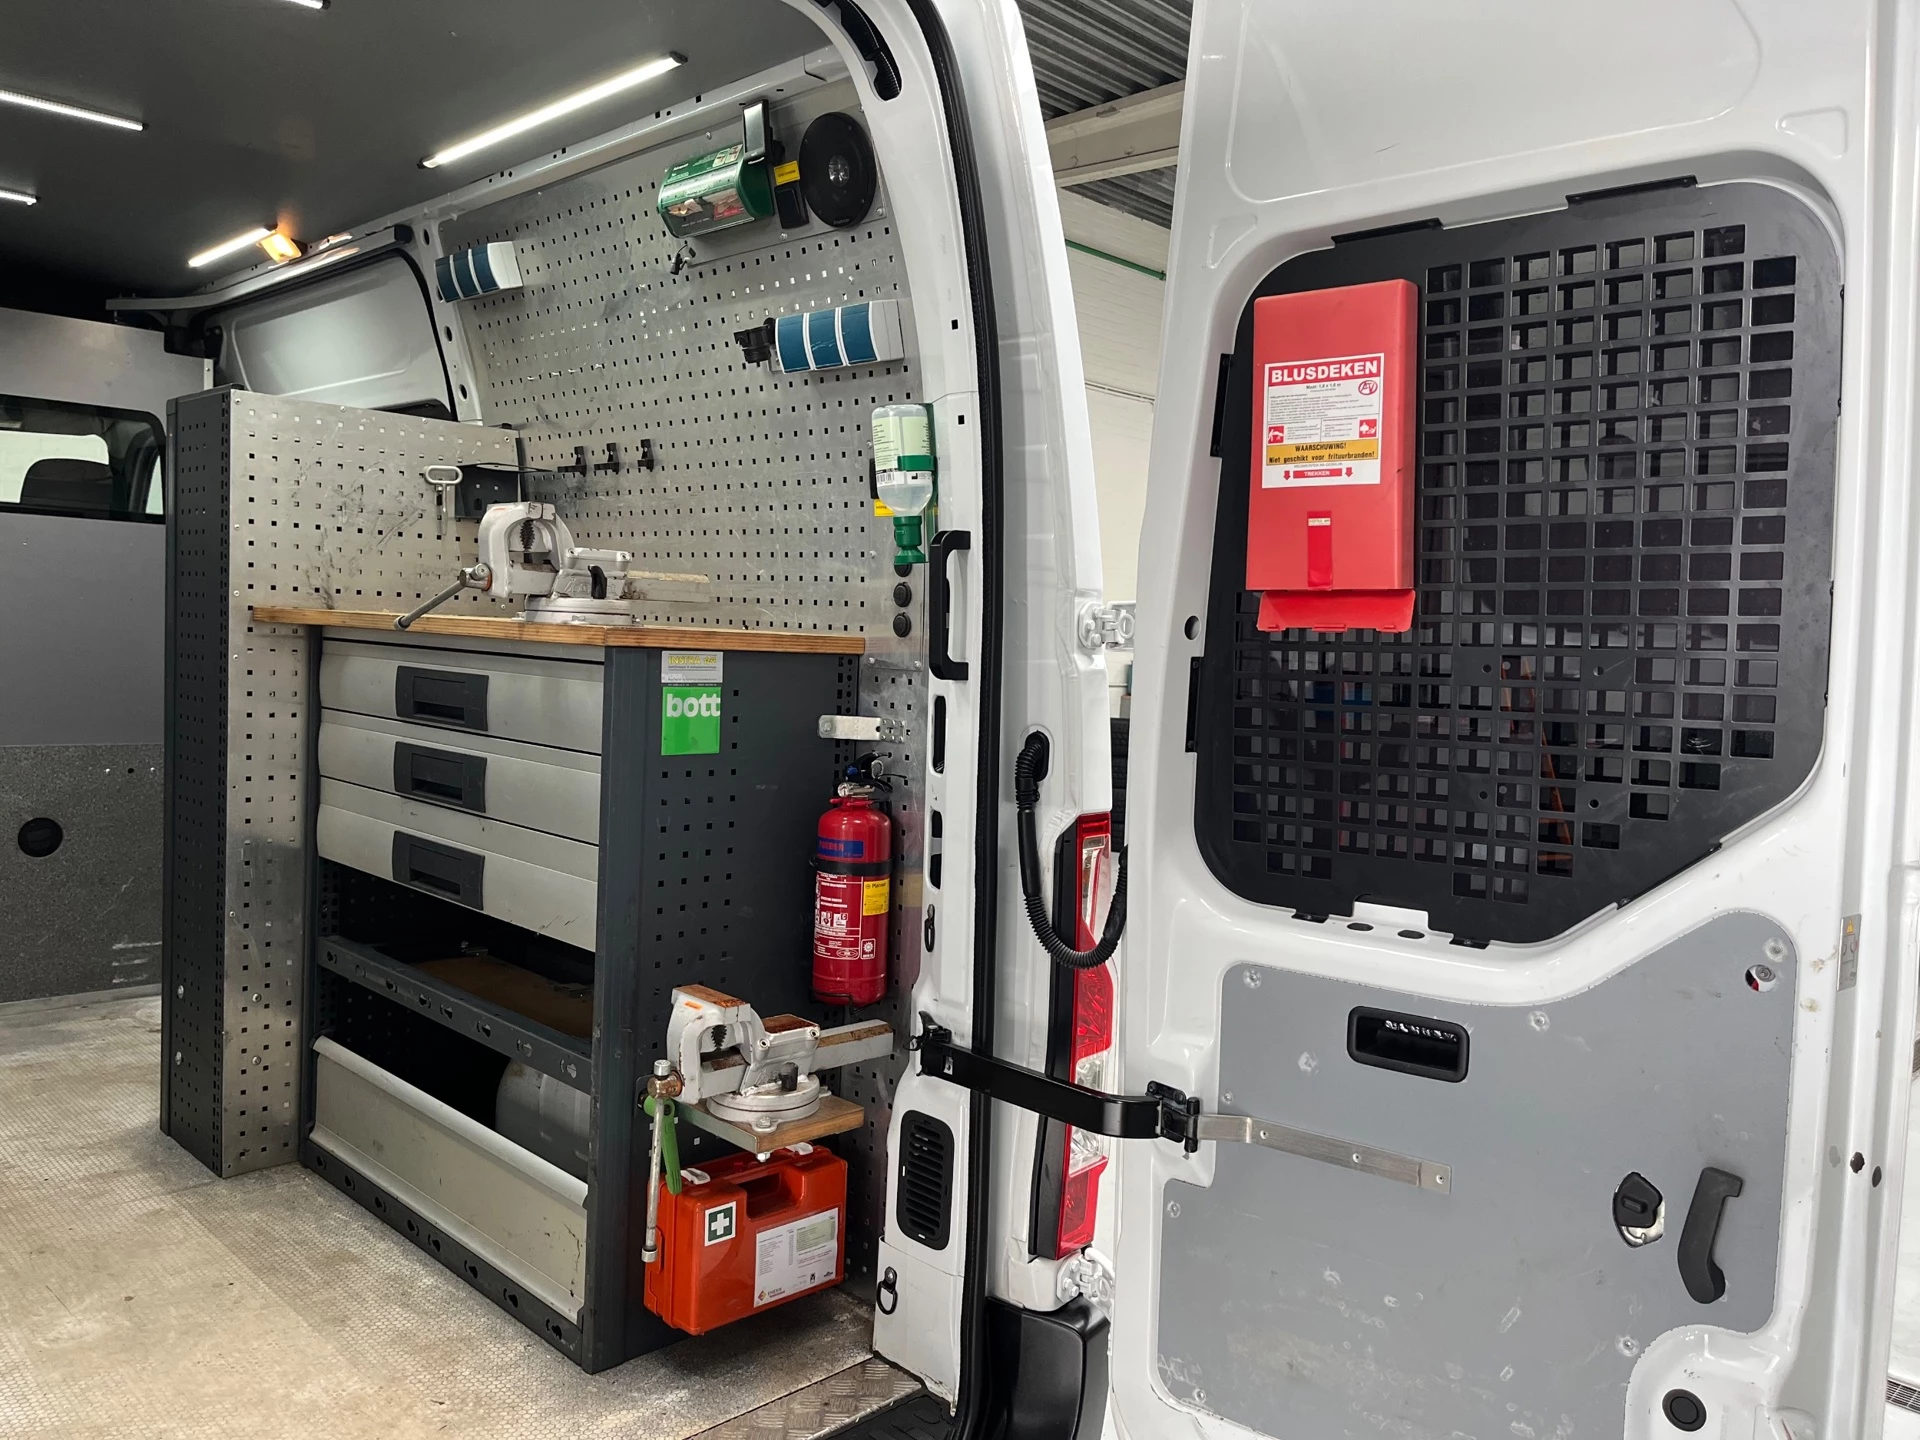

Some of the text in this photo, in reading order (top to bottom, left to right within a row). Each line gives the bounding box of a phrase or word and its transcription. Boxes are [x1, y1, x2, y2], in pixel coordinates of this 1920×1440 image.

[1271, 360, 1378, 383] BLUSDEKEN
[1295, 443, 1347, 452] WAARSCHUWING!
[1283, 455, 1309, 464] geschikt
[1328, 451, 1375, 460] frituurbranden!
[668, 655, 701, 665] INSTRA
[666, 693, 721, 718] bott
